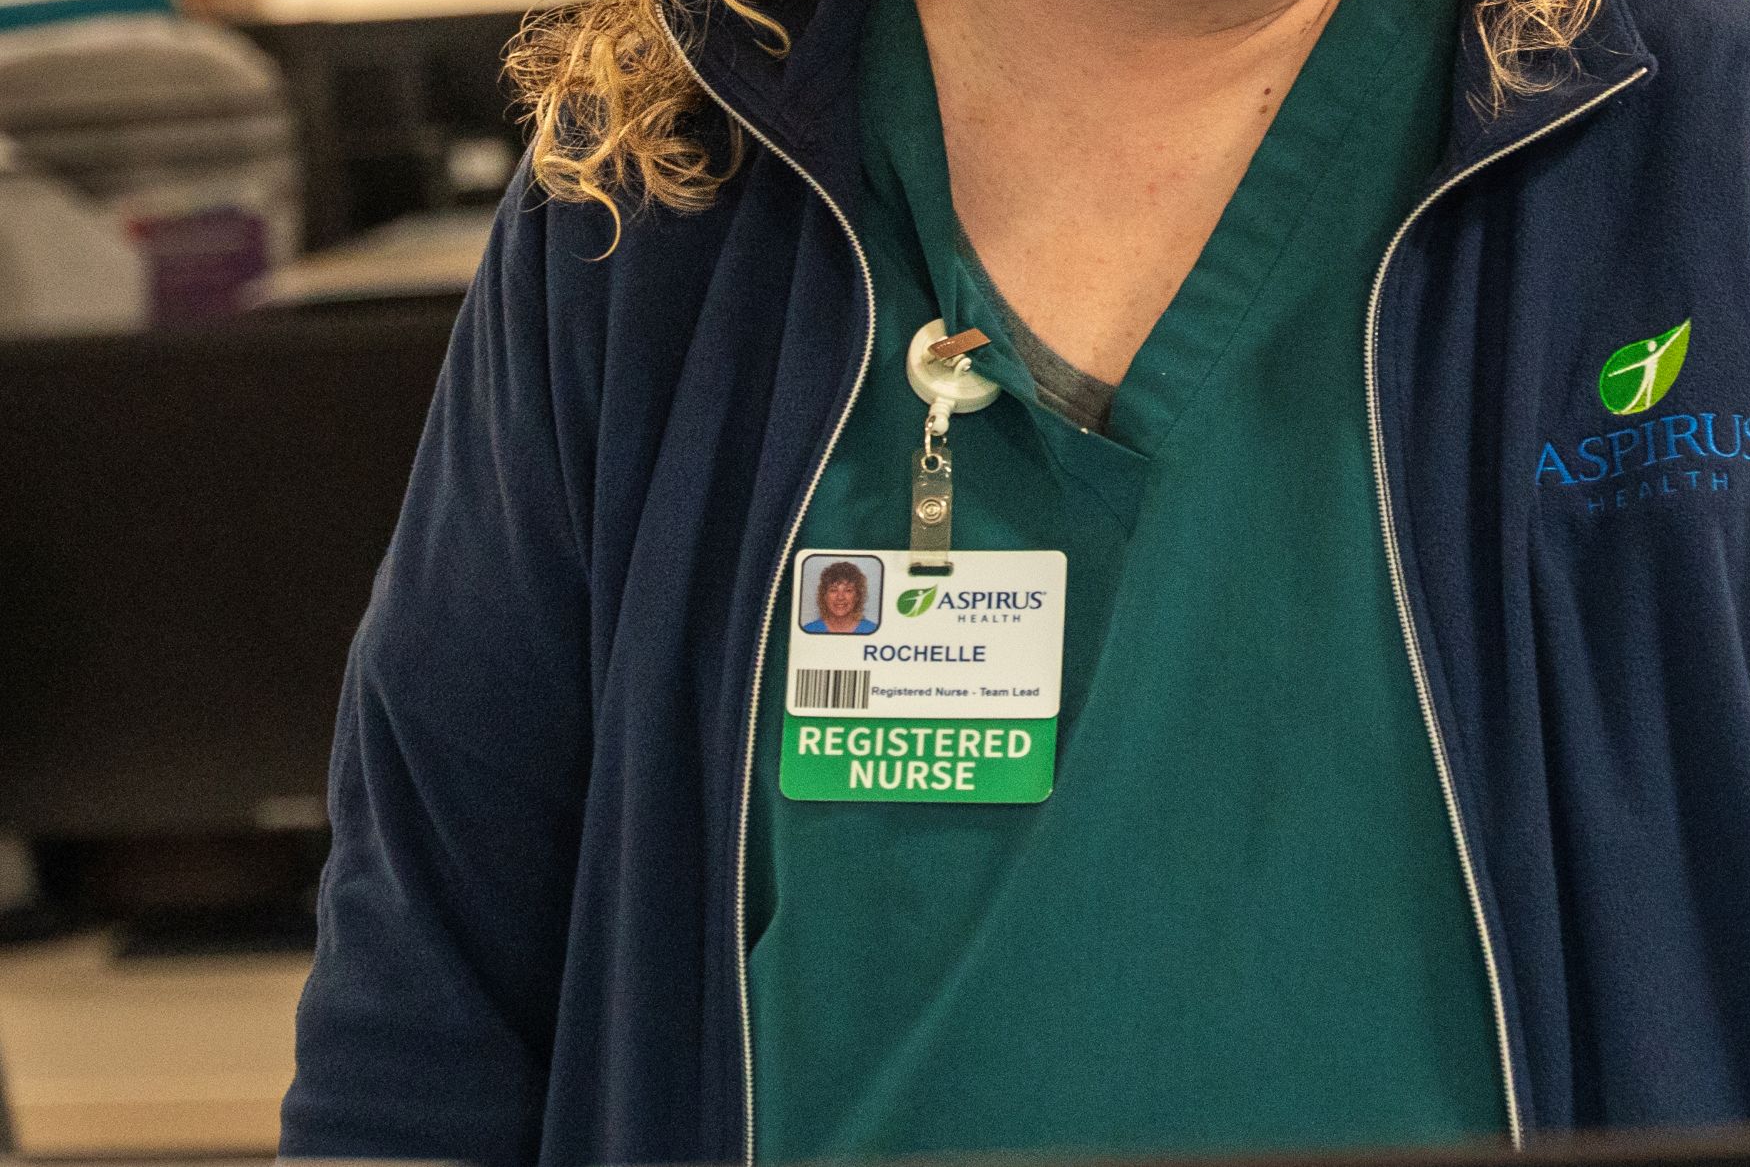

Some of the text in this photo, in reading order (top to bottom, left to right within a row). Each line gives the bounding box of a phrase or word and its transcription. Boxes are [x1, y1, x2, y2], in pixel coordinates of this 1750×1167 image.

[1585, 470, 1729, 514] HEALTH
[937, 590, 1043, 610] ASPIRUS
[957, 614, 1022, 623] HEALTH
[863, 644, 987, 663] ROCHELLE
[871, 686, 932, 699] Registered
[935, 687, 969, 697] Nurse
[979, 687, 1009, 697] Team
[1012, 687, 1040, 697] Lead
[798, 726, 1032, 759] REGISTERED
[849, 760, 976, 791] NURSE
